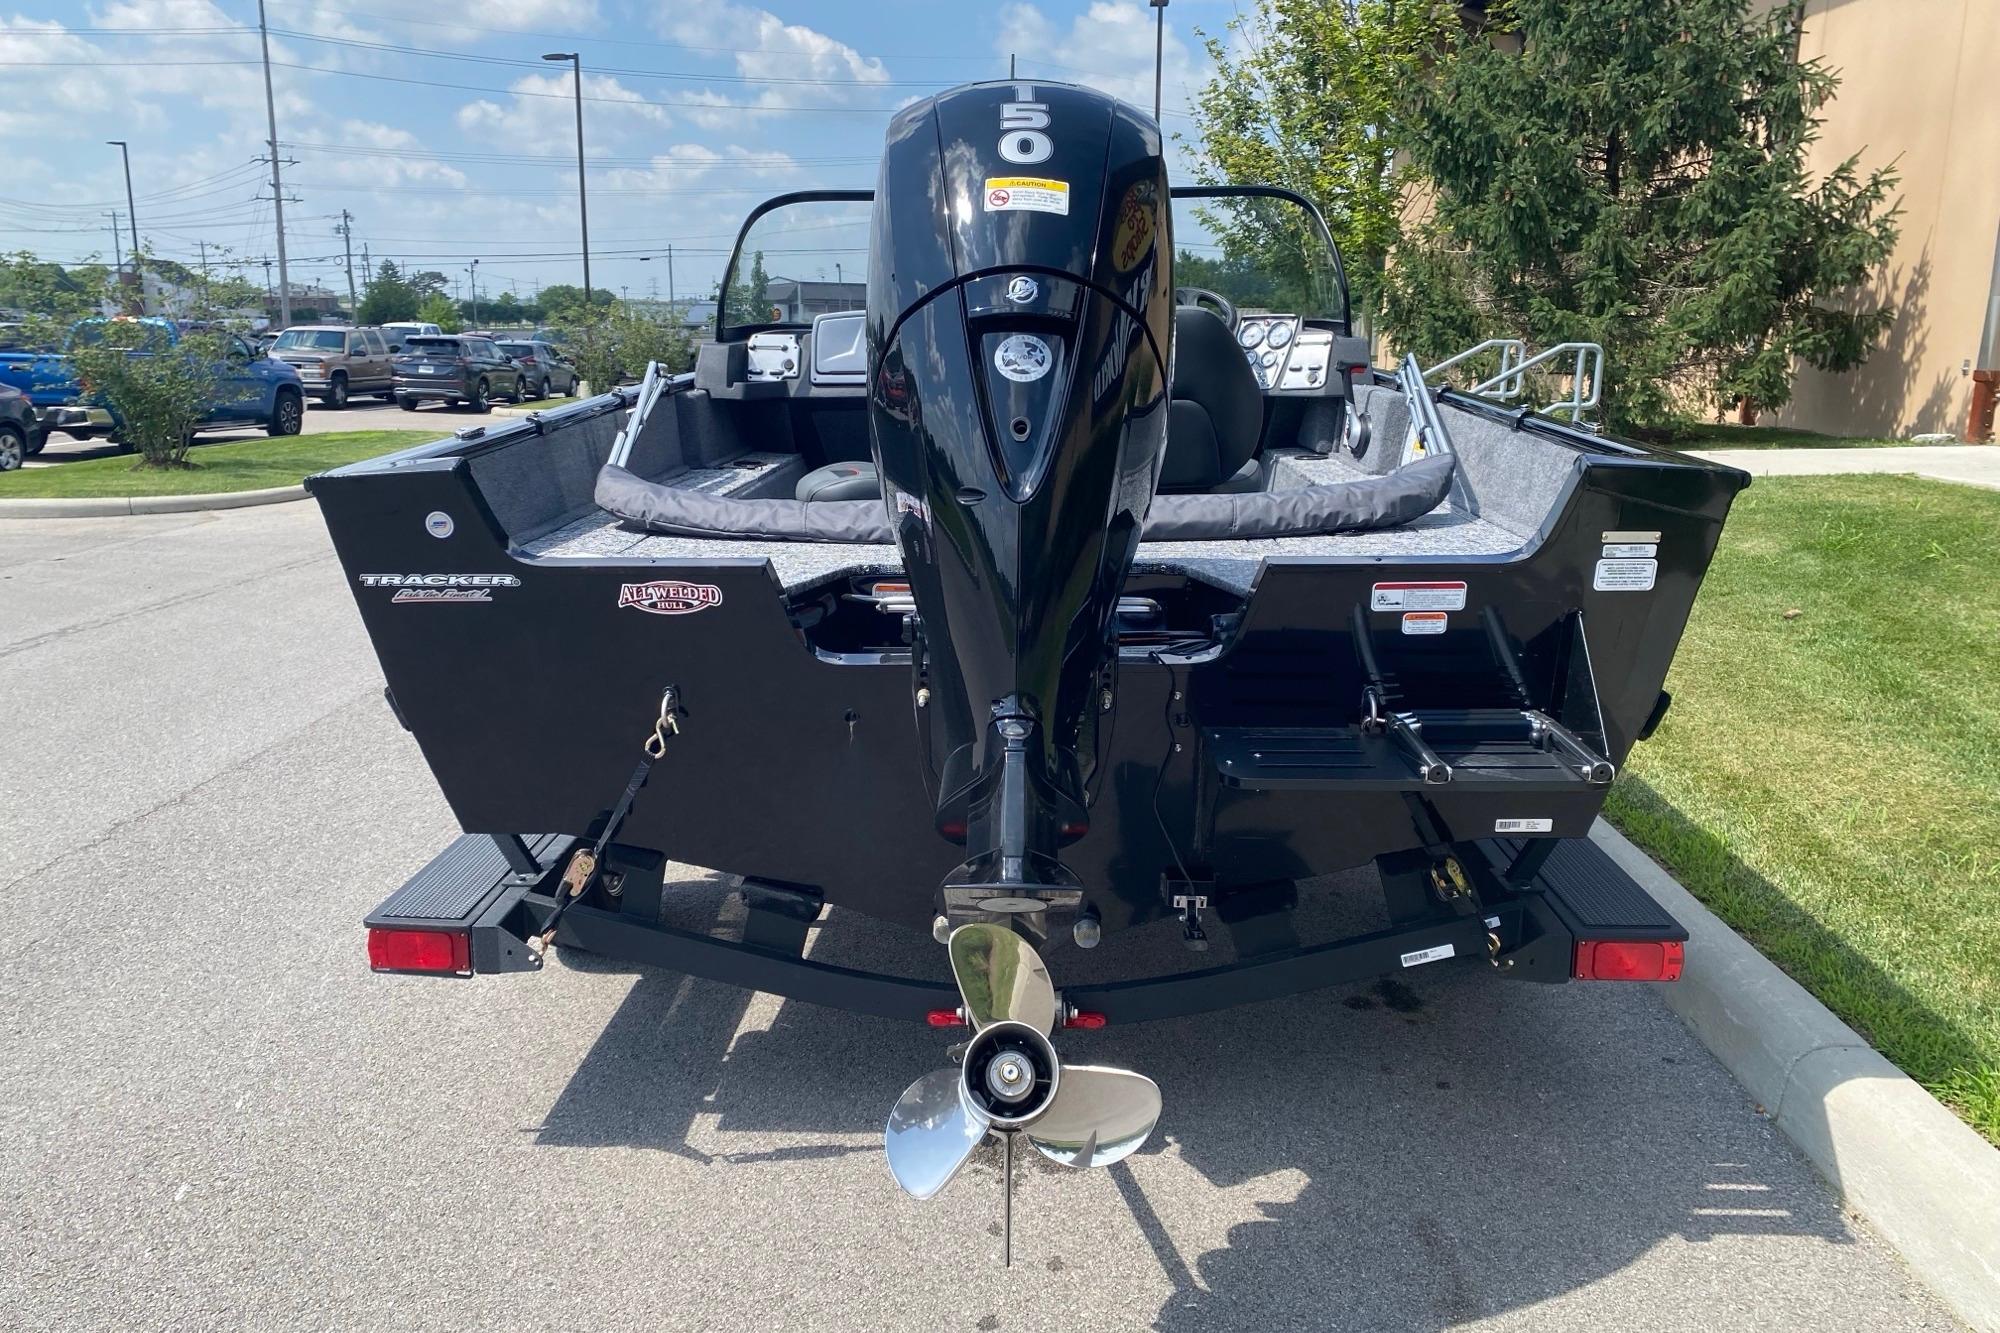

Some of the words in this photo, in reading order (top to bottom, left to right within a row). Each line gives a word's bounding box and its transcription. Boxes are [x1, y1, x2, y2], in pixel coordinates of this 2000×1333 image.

[998, 85, 1054, 165] 150
[360, 574, 514, 586] TRACKER
[621, 585, 653, 604] ALL
[654, 586, 720, 604] WELDED
[657, 601, 686, 609] HULL
